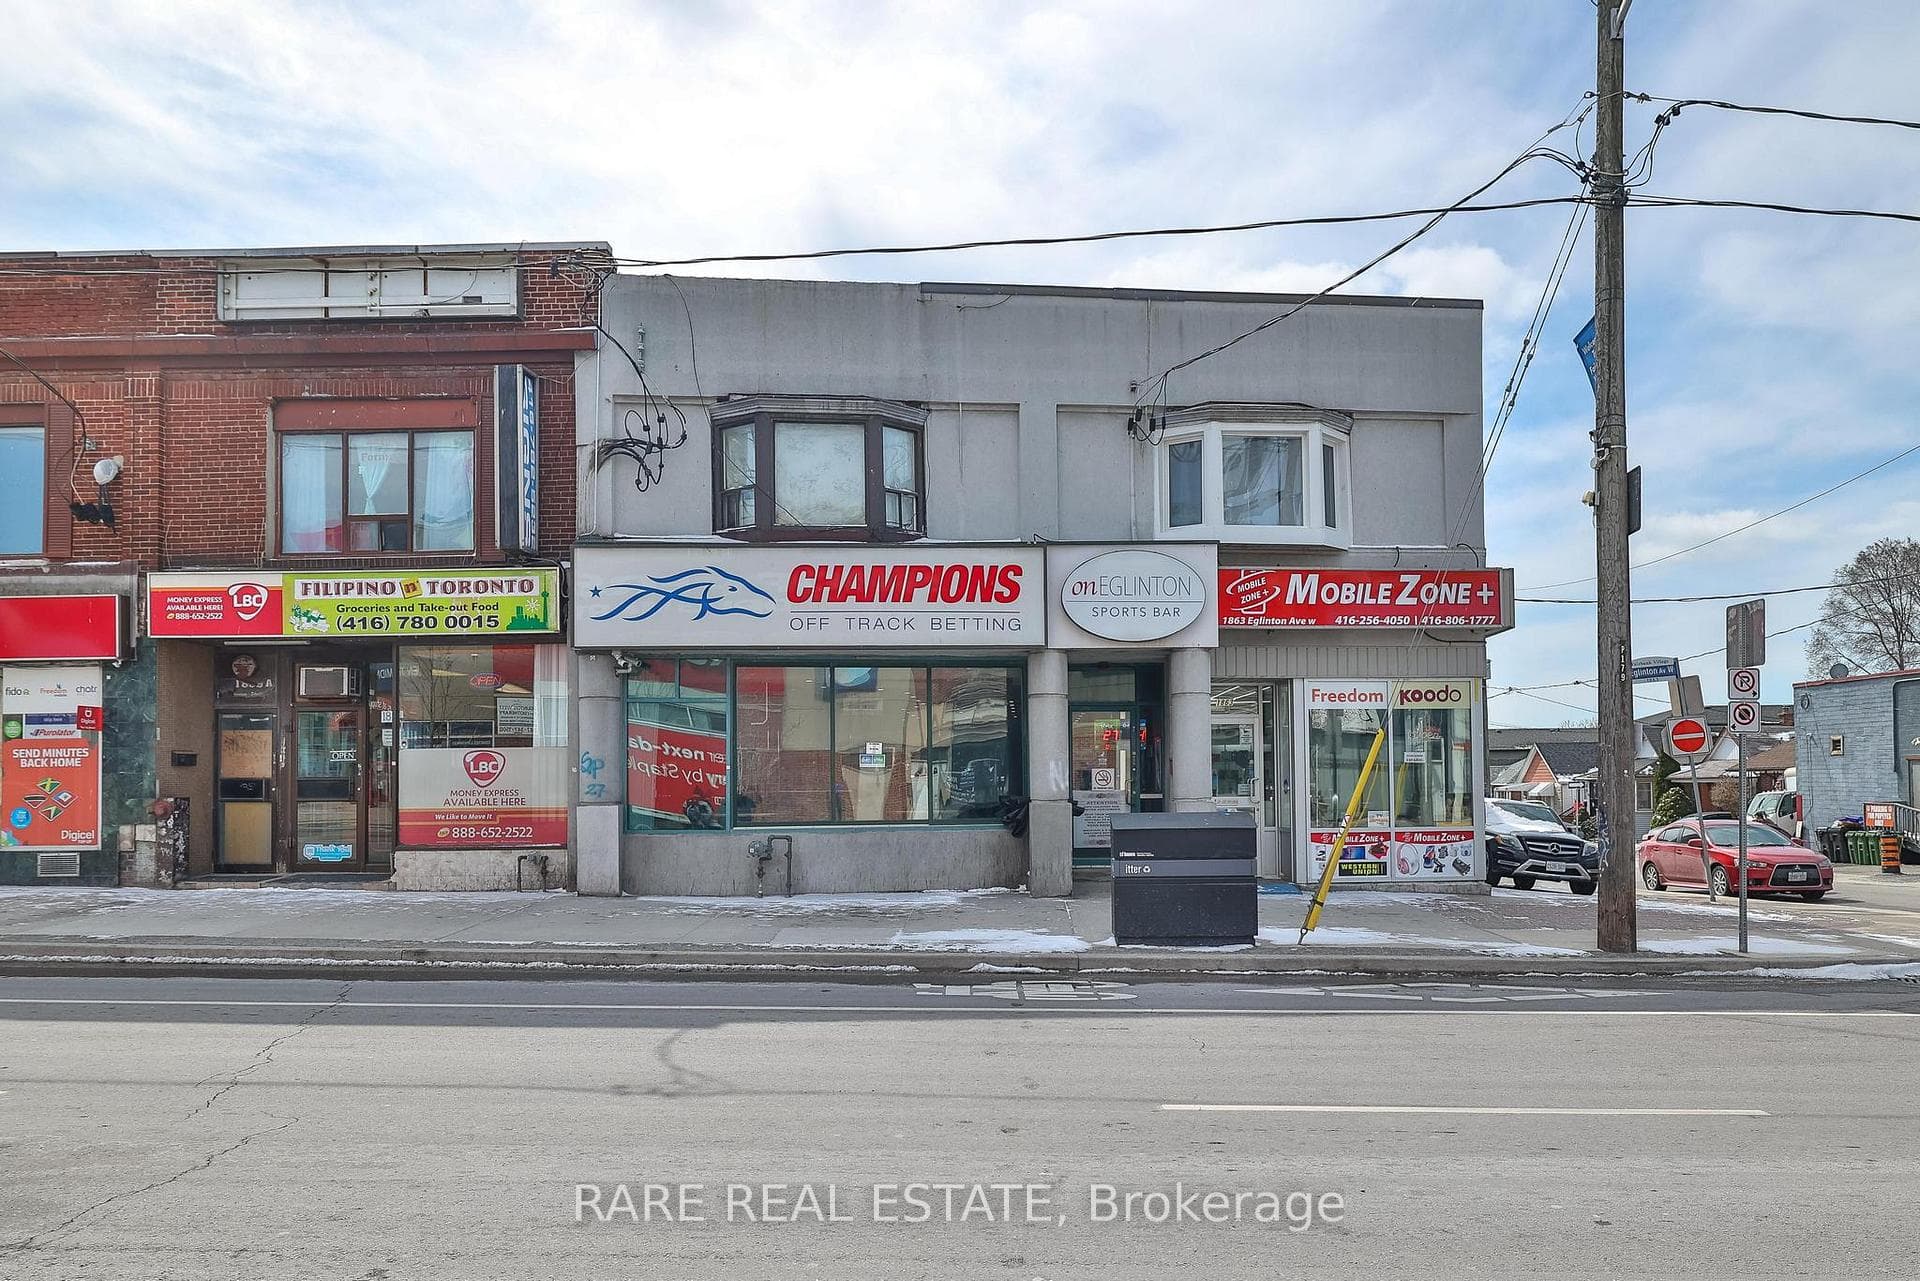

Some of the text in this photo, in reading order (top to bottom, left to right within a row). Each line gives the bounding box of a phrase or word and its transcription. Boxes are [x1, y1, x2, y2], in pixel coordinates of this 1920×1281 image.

[301, 580, 397, 597] FILIPINO
[427, 579, 536, 596] TORONTO
[786, 563, 1021, 605] CHAMPIONS
[1237, 578, 1266, 594] MOBILE
[233, 594, 262, 608] LBC
[1241, 590, 1262, 605] ZONE
[337, 602, 500, 613] Groceries and Take-out Food
[1092, 607, 1182, 617] SPORTS BAR
[175, 612, 223, 620] 888-652-2522
[1222, 616, 1246, 625] 1863
[1247, 616, 1288, 627] Eglinton
[1289, 616, 1306, 625] Ave
[1335, 616, 1410, 625] 416-256-4050
[1421, 615, 1496, 625] 416-806-1777
[337, 614, 500, 632] (416) 780 0015
[790, 616, 1021, 632] OFF TRACK BETTING
[5, 686, 22, 696] fido
[1311, 688, 1383, 703] Freedom
[12, 748, 89, 758] SEND MINUTES
[331, 752, 356, 760] OPEN
[20, 757, 81, 768] BACK HOME
[469, 760, 499, 774] LBC
[450, 789, 519, 797] MONEY EXPRESS
[443, 797, 526, 806] AVAILABLE HERE
[468, 813, 484, 821] Move
[61, 830, 95, 841] Digicel
[451, 826, 534, 839] 888-652-2522
